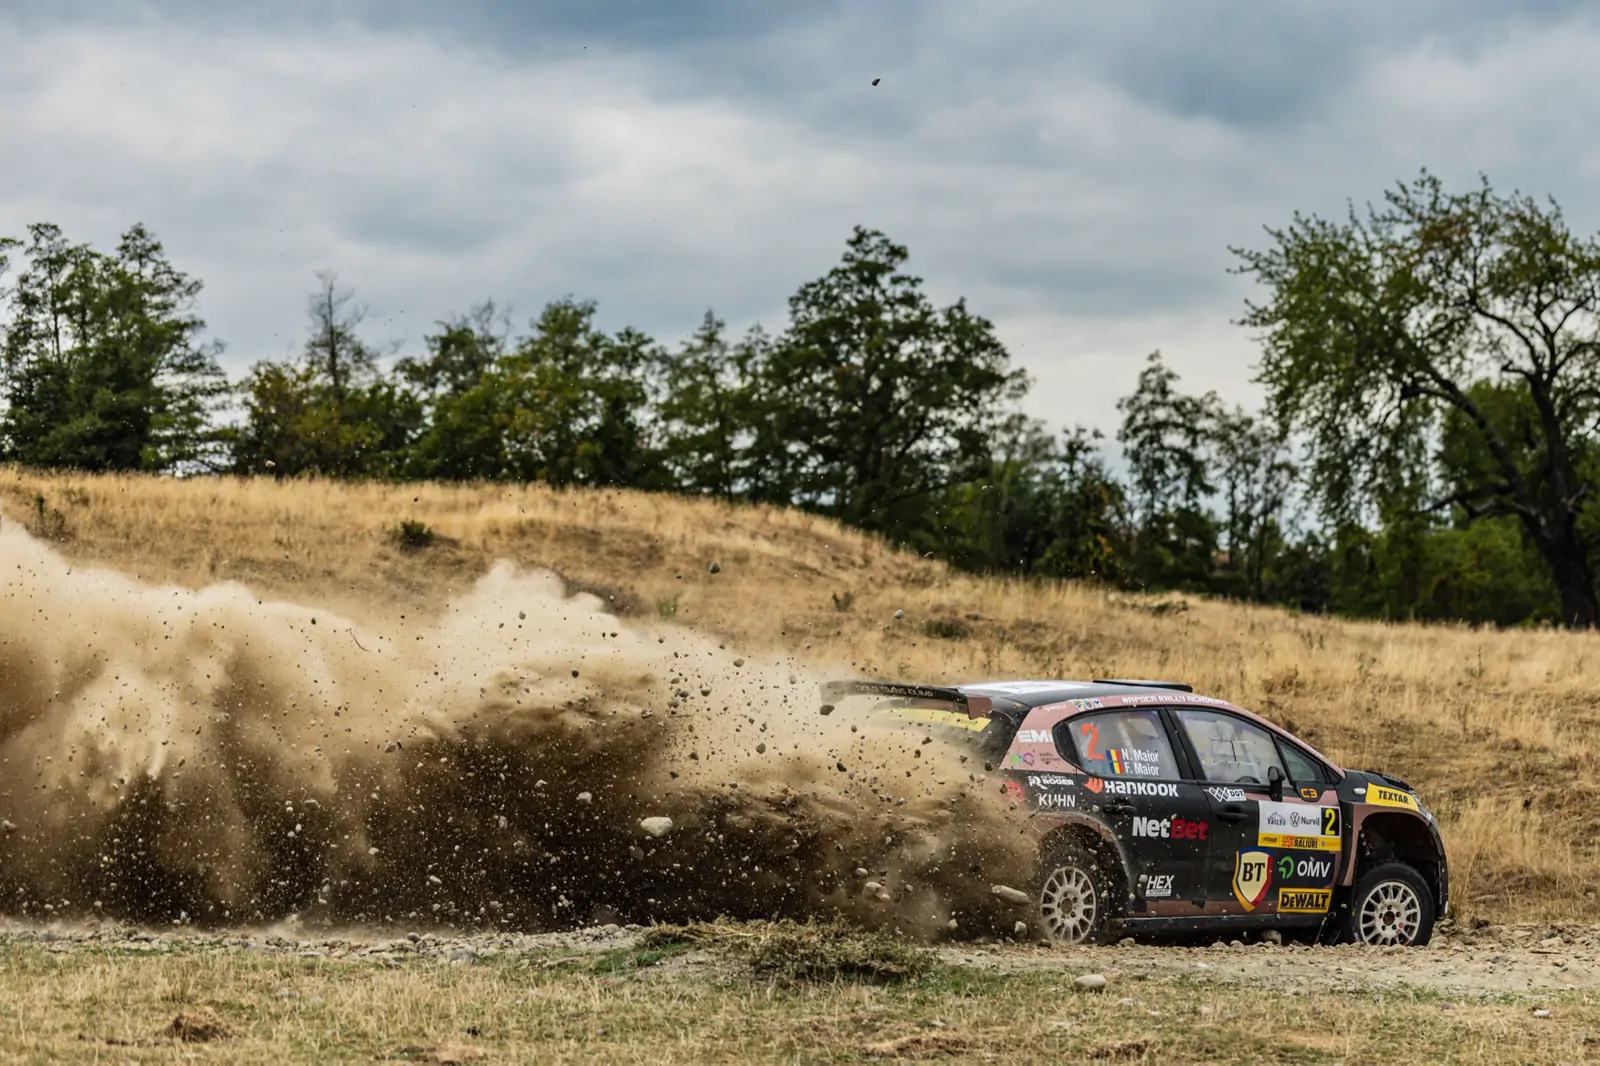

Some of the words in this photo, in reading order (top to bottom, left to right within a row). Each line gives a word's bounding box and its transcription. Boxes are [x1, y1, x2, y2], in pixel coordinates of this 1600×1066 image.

[1081, 722, 1105, 760] 2
[1121, 748, 1133, 760] N.
[1134, 748, 1159, 763] Maior
[1124, 762, 1133, 774] F.
[1134, 762, 1159, 776] Maior
[1039, 793, 1076, 807] KUHN
[1378, 789, 1409, 804] TEXTAR
[1132, 816, 1208, 839] NetBet
[1325, 808, 1336, 835] 2
[1242, 862, 1265, 882] BT
[1297, 859, 1331, 878] OMV
[1146, 875, 1175, 889] HEX
